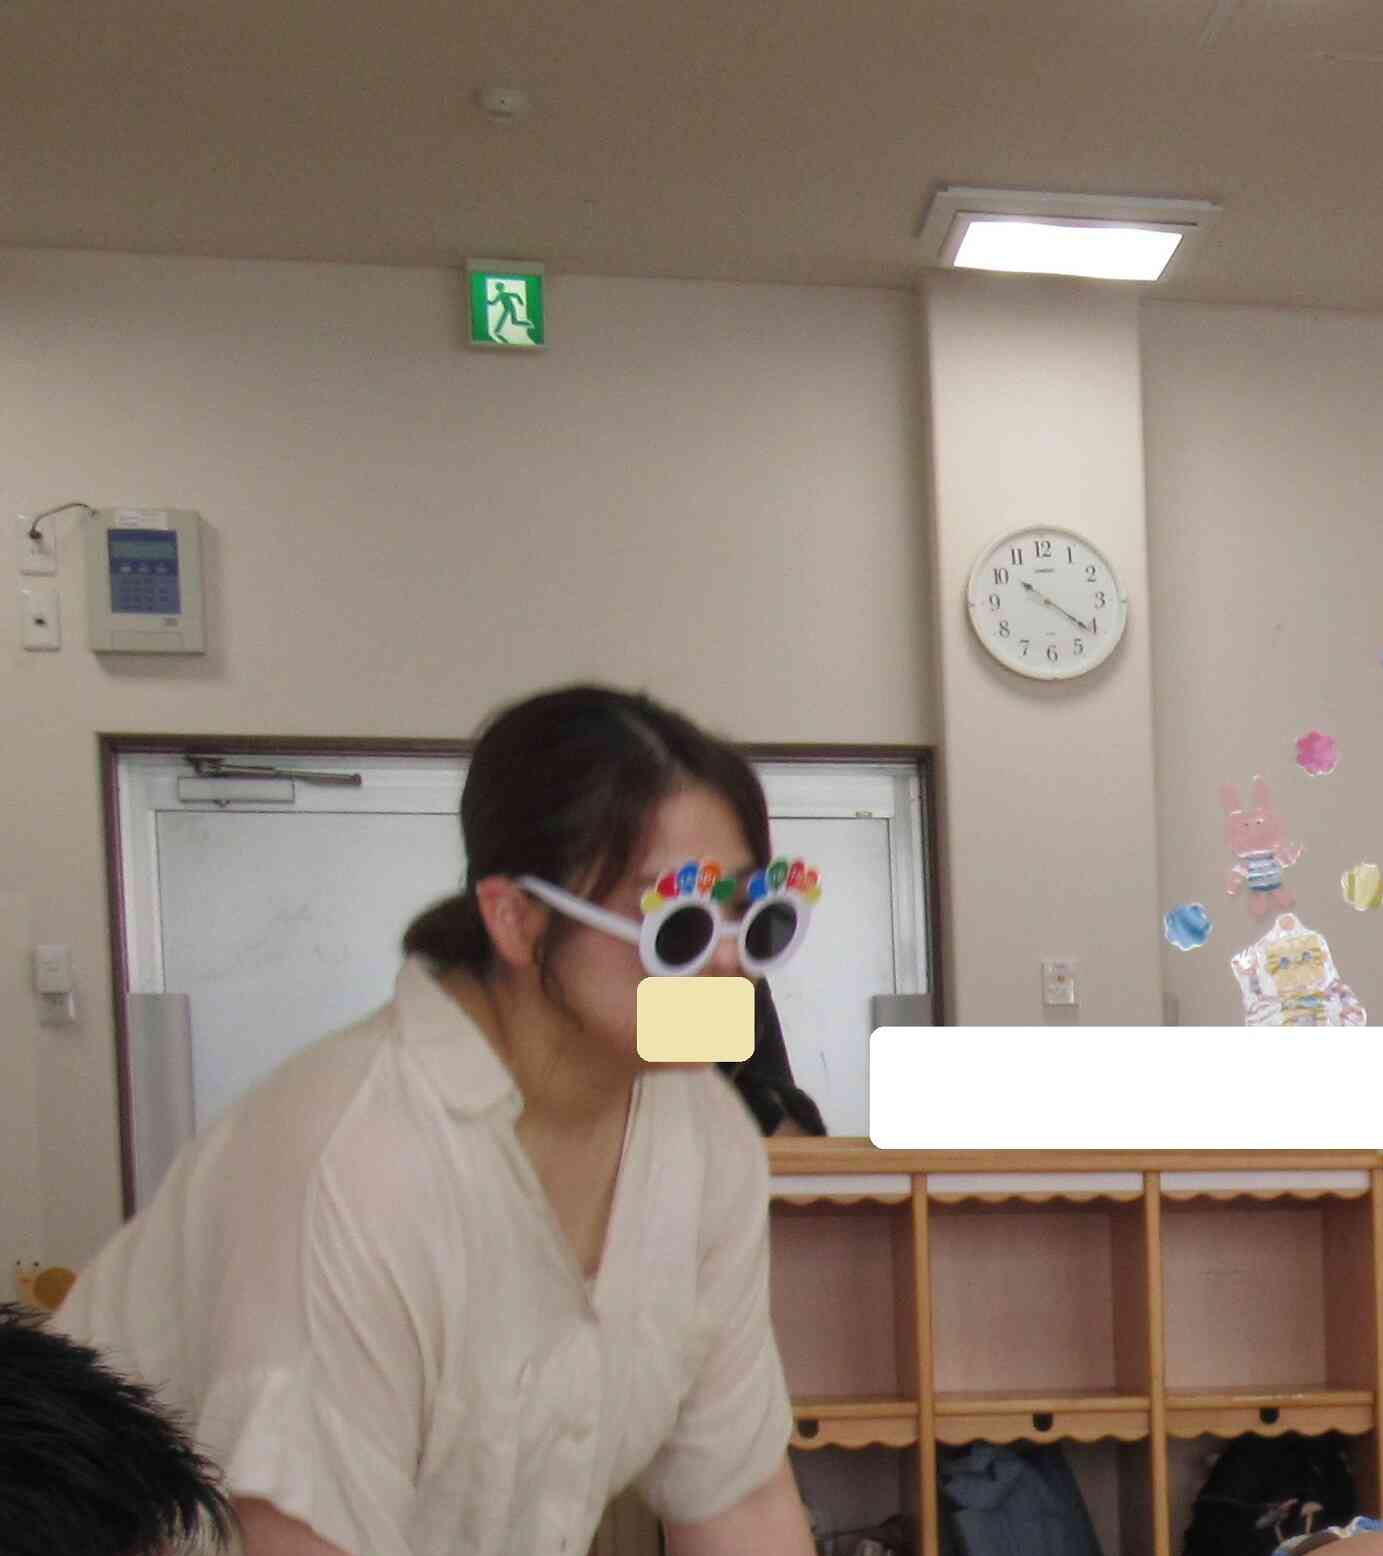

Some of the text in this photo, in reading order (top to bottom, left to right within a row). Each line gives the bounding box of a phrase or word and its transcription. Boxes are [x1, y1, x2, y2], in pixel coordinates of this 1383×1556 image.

[1009, 548, 1023, 566] 11
[1034, 540, 1052, 558] 12
[1066, 545, 1073, 564] 1
[993, 567, 1009, 585] 10
[1085, 565, 1097, 582] 2
[989, 593, 1001, 612] 9
[1094, 592, 1106, 609] 3
[999, 619, 1011, 638] 8
[1019, 639, 1031, 657] 7
[1046, 644, 1058, 663] 6
[1072, 638, 1084, 656] 5
